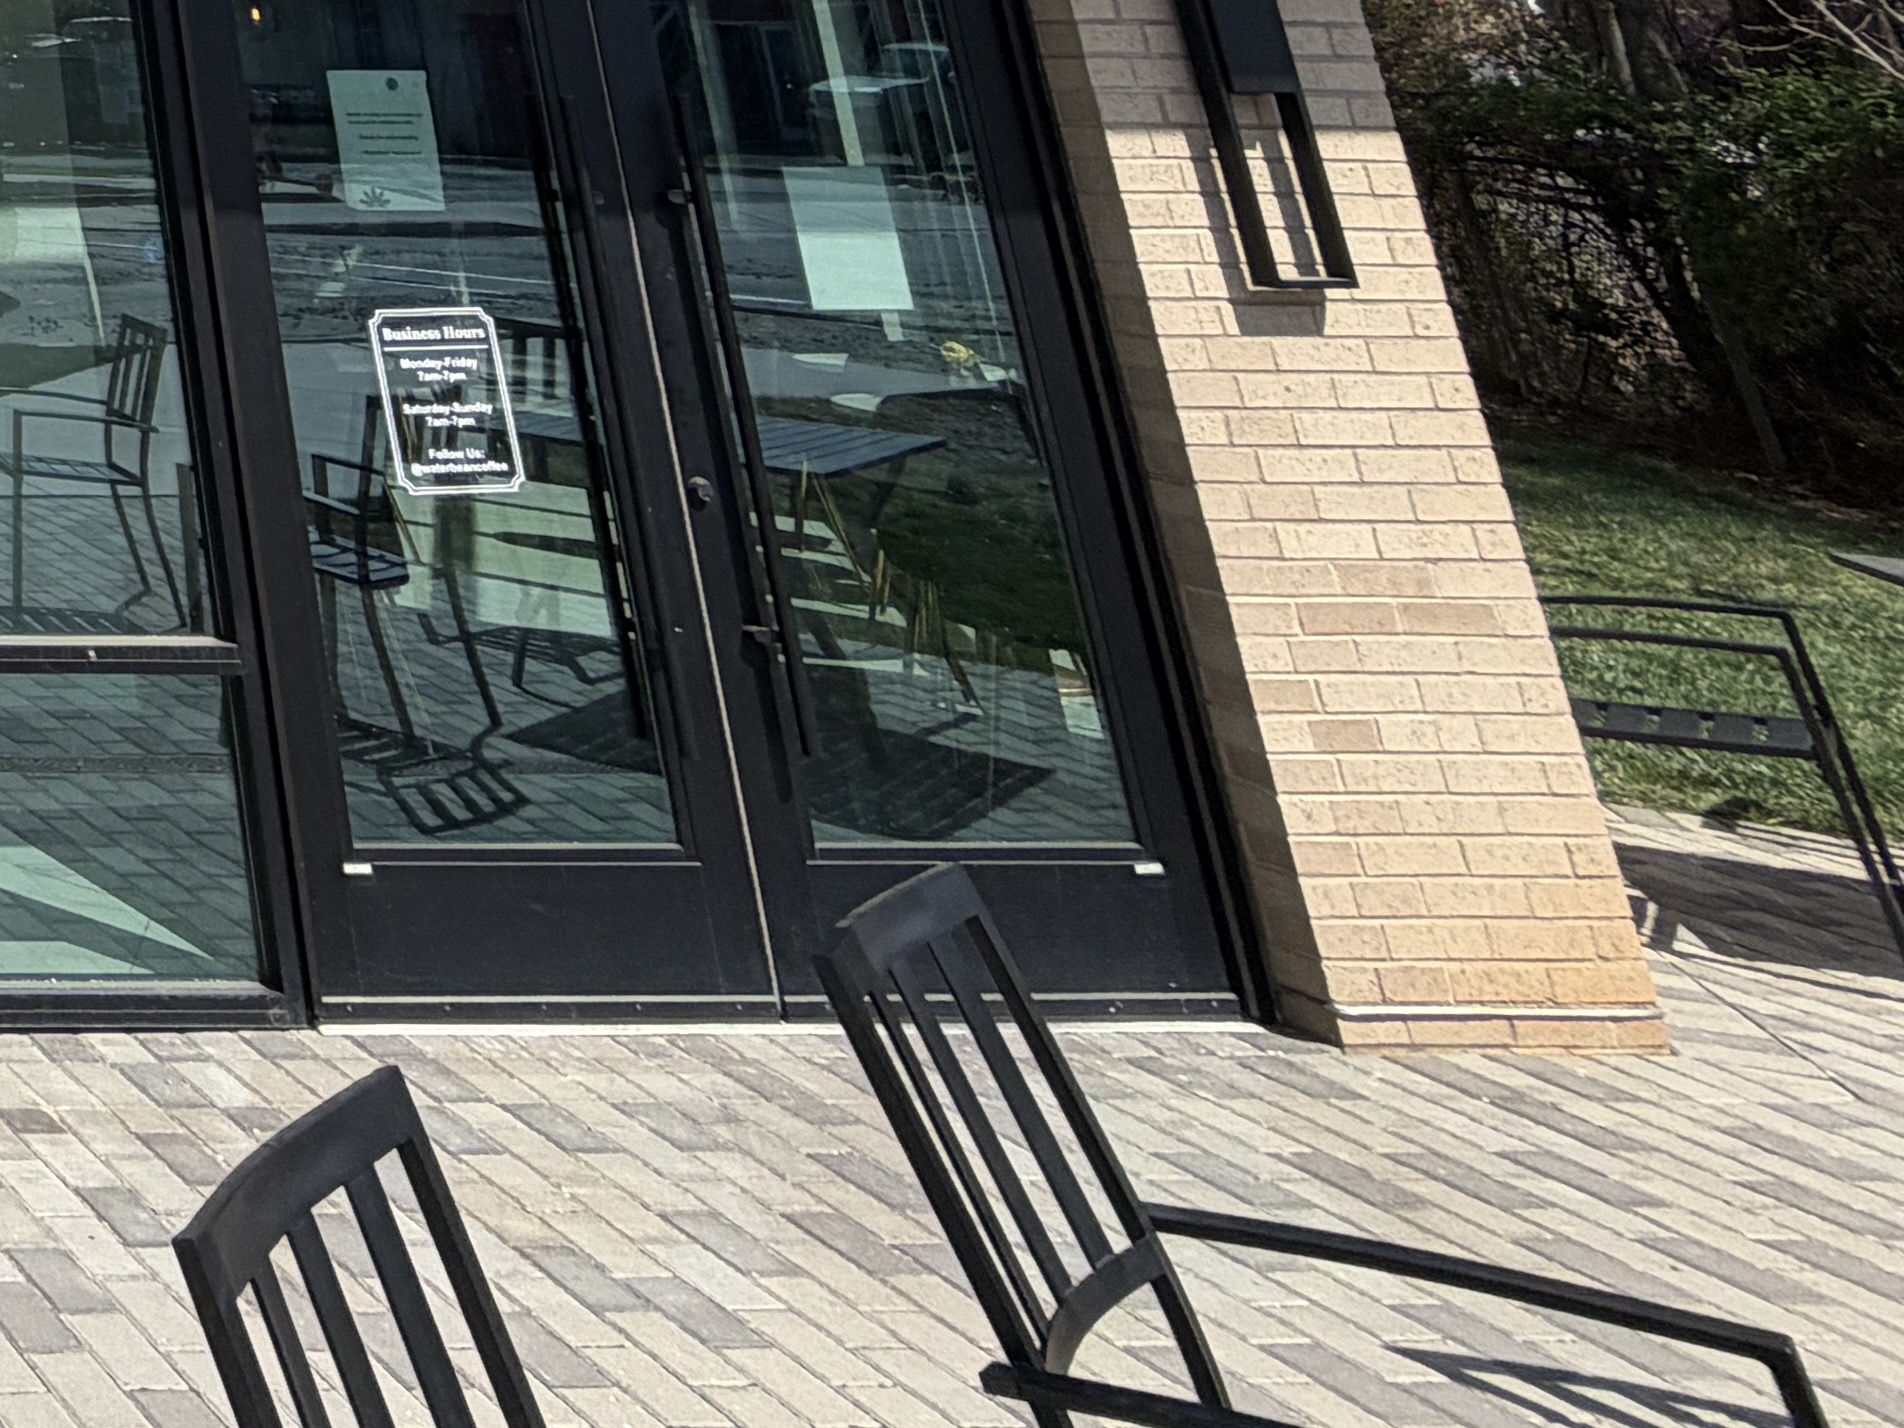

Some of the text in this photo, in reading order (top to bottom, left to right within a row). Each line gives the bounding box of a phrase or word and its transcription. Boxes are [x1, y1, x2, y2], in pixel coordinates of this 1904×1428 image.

[382, 326, 485, 341] Business Hours
[428, 449, 464, 460] Follow
